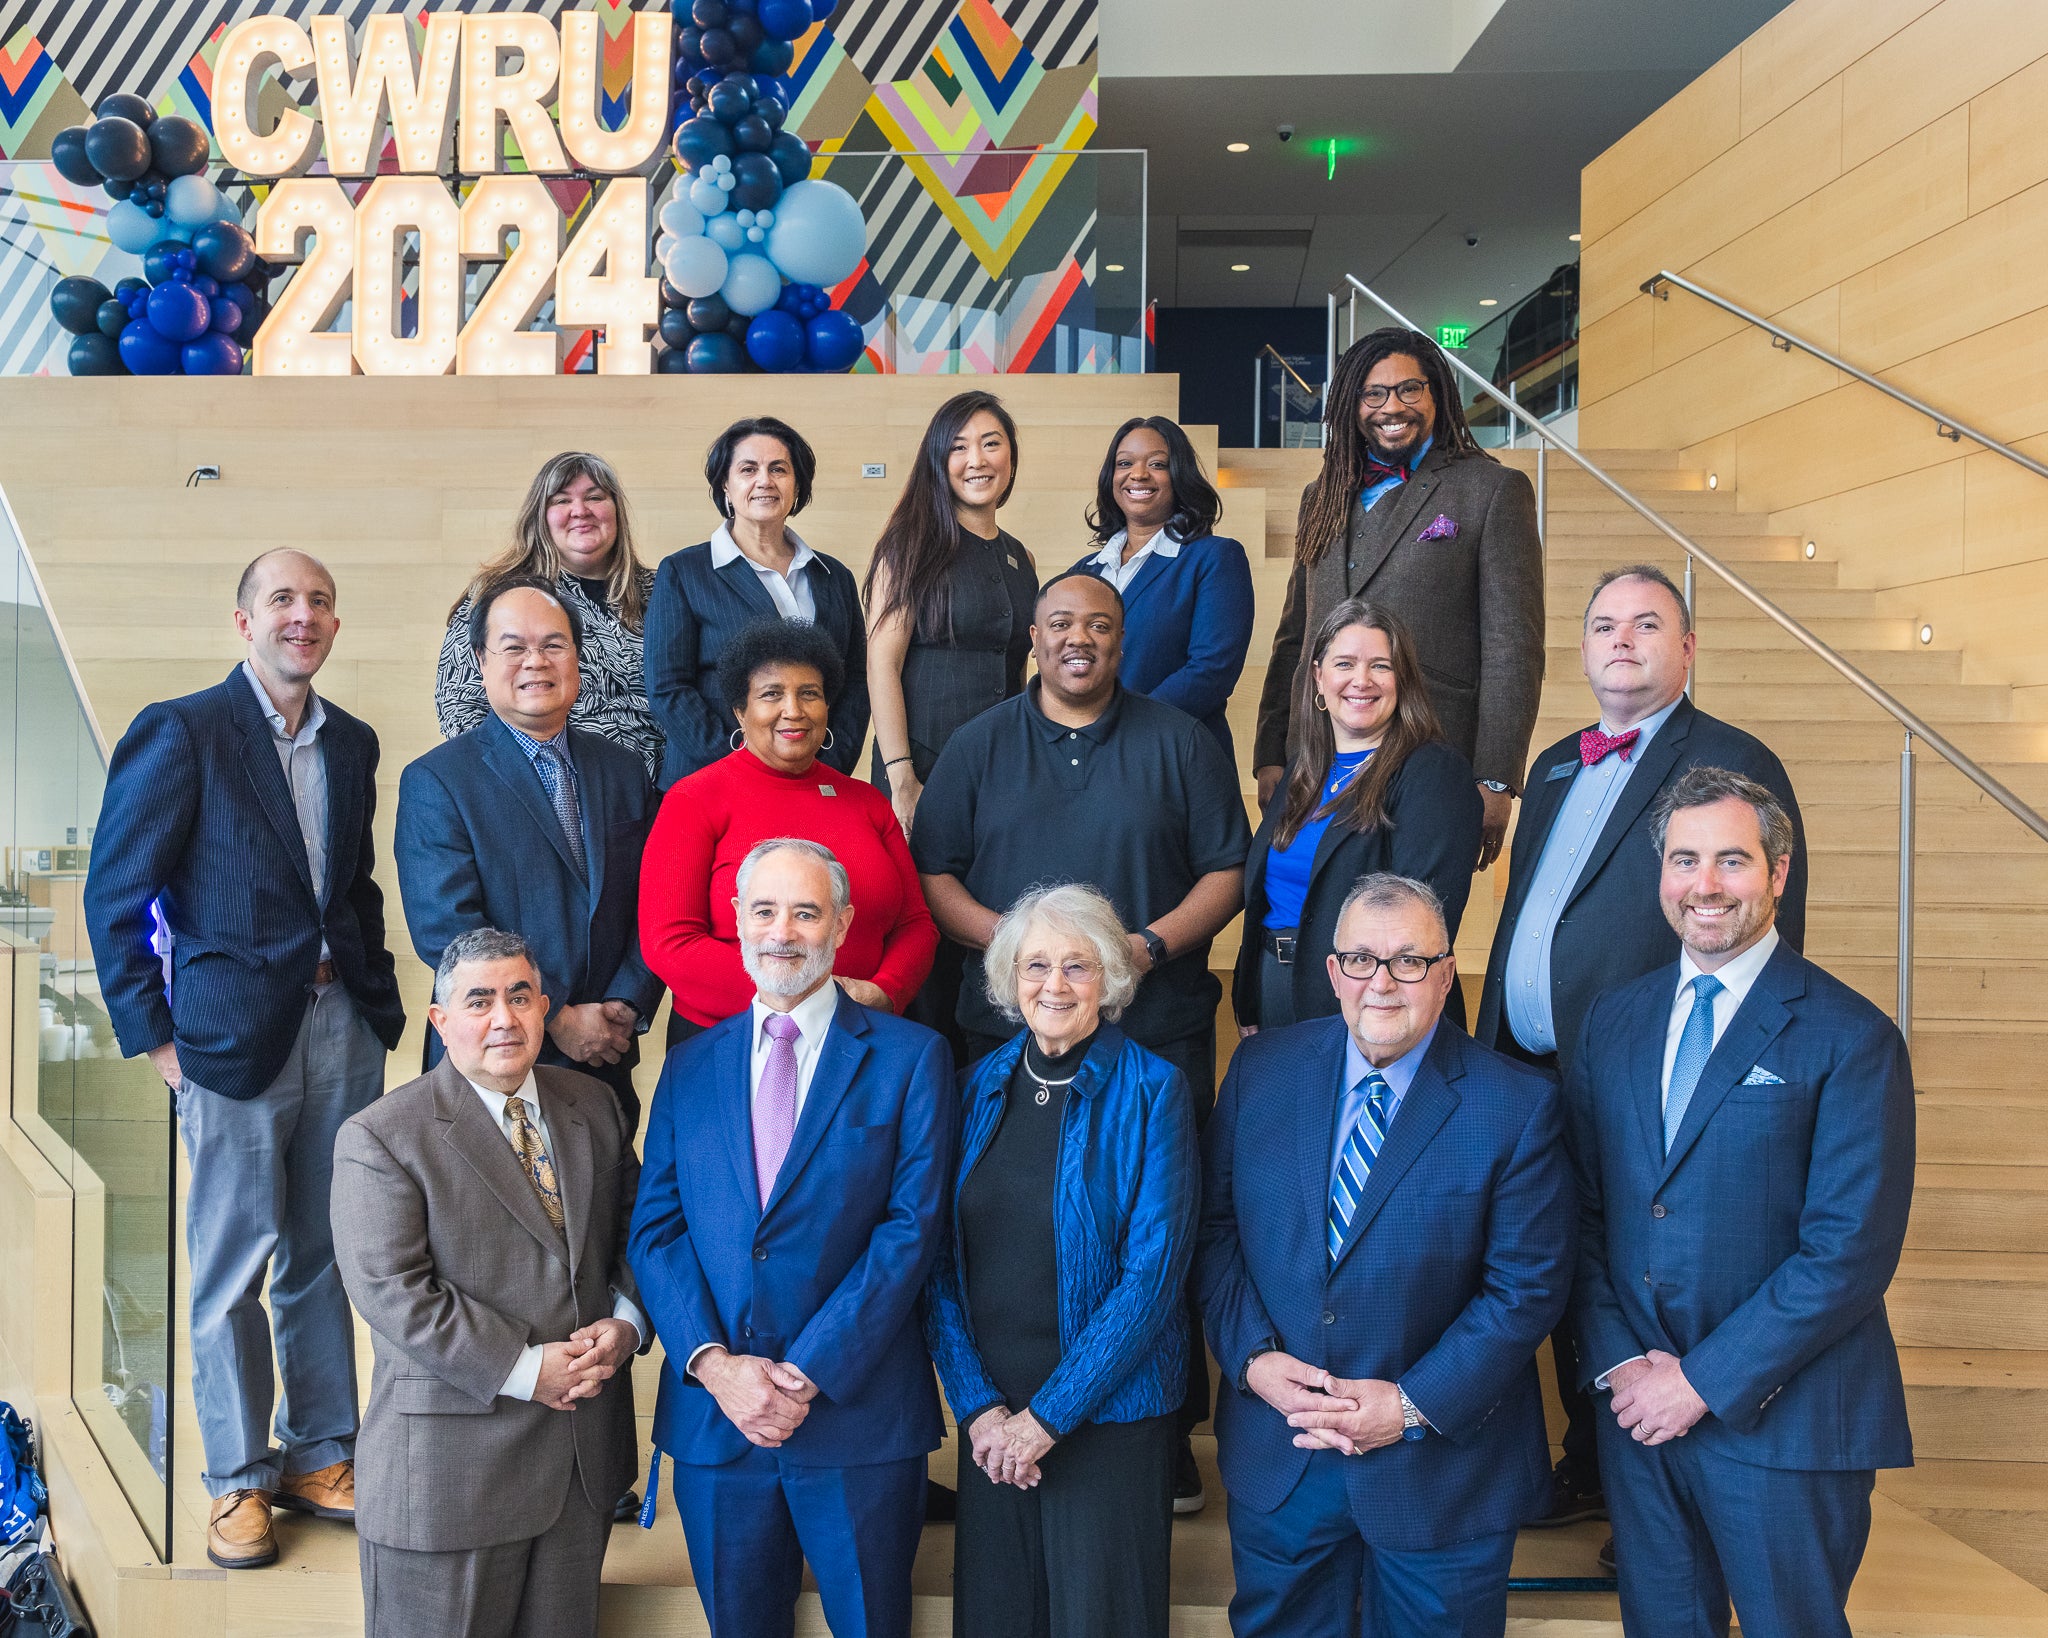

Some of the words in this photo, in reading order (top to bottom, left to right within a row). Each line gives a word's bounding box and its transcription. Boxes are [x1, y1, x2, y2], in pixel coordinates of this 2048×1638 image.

[210, 11, 673, 175] CWRU
[252, 175, 659, 376] 2024
[1443, 327, 1467, 345] EXIT
